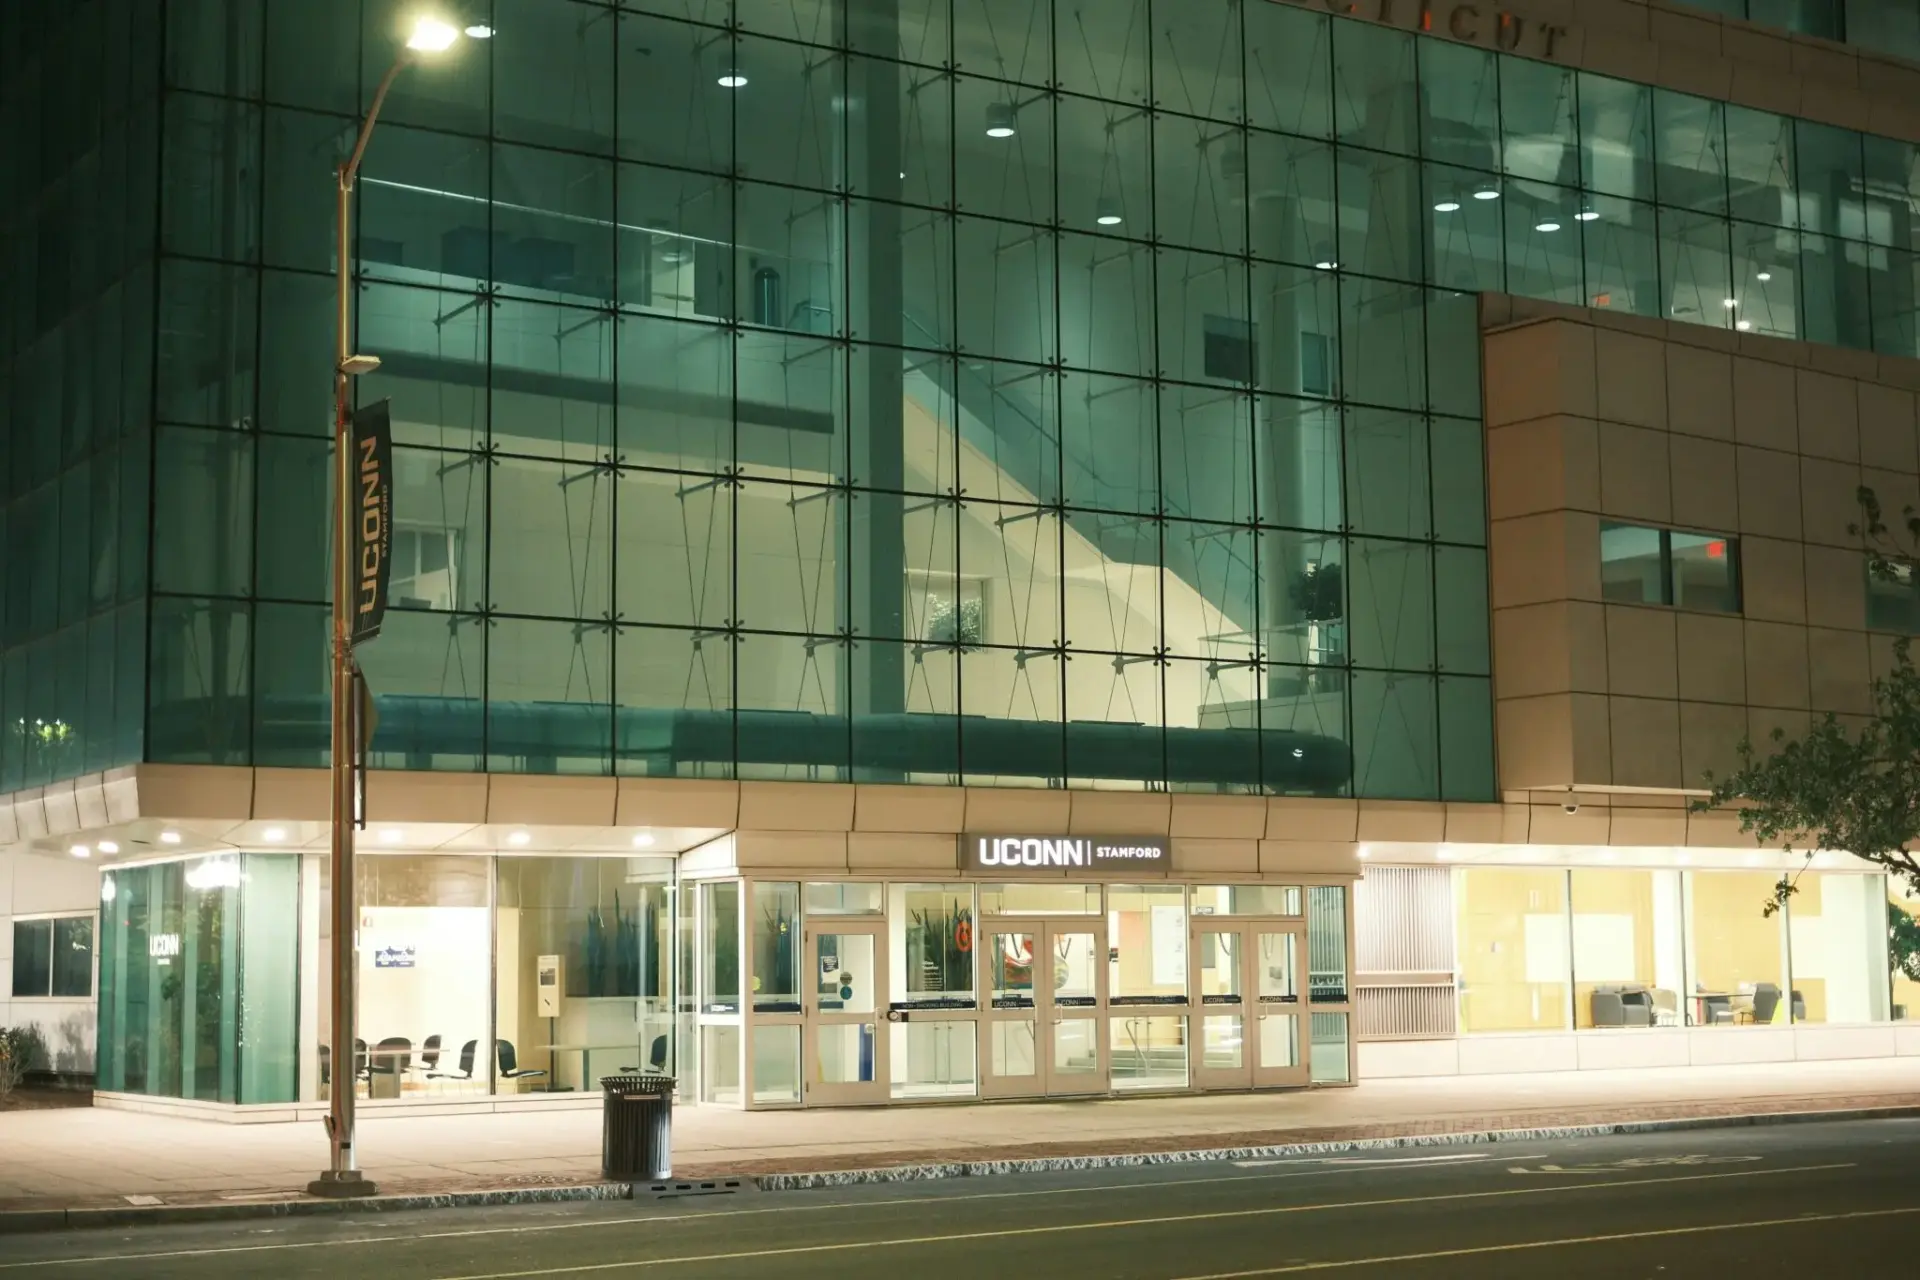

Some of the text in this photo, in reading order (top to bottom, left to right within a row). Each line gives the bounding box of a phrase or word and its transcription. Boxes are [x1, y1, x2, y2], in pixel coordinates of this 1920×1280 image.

[360, 436, 380, 614] UCONN
[979, 838, 1161, 866] UCONN STAMFORD
